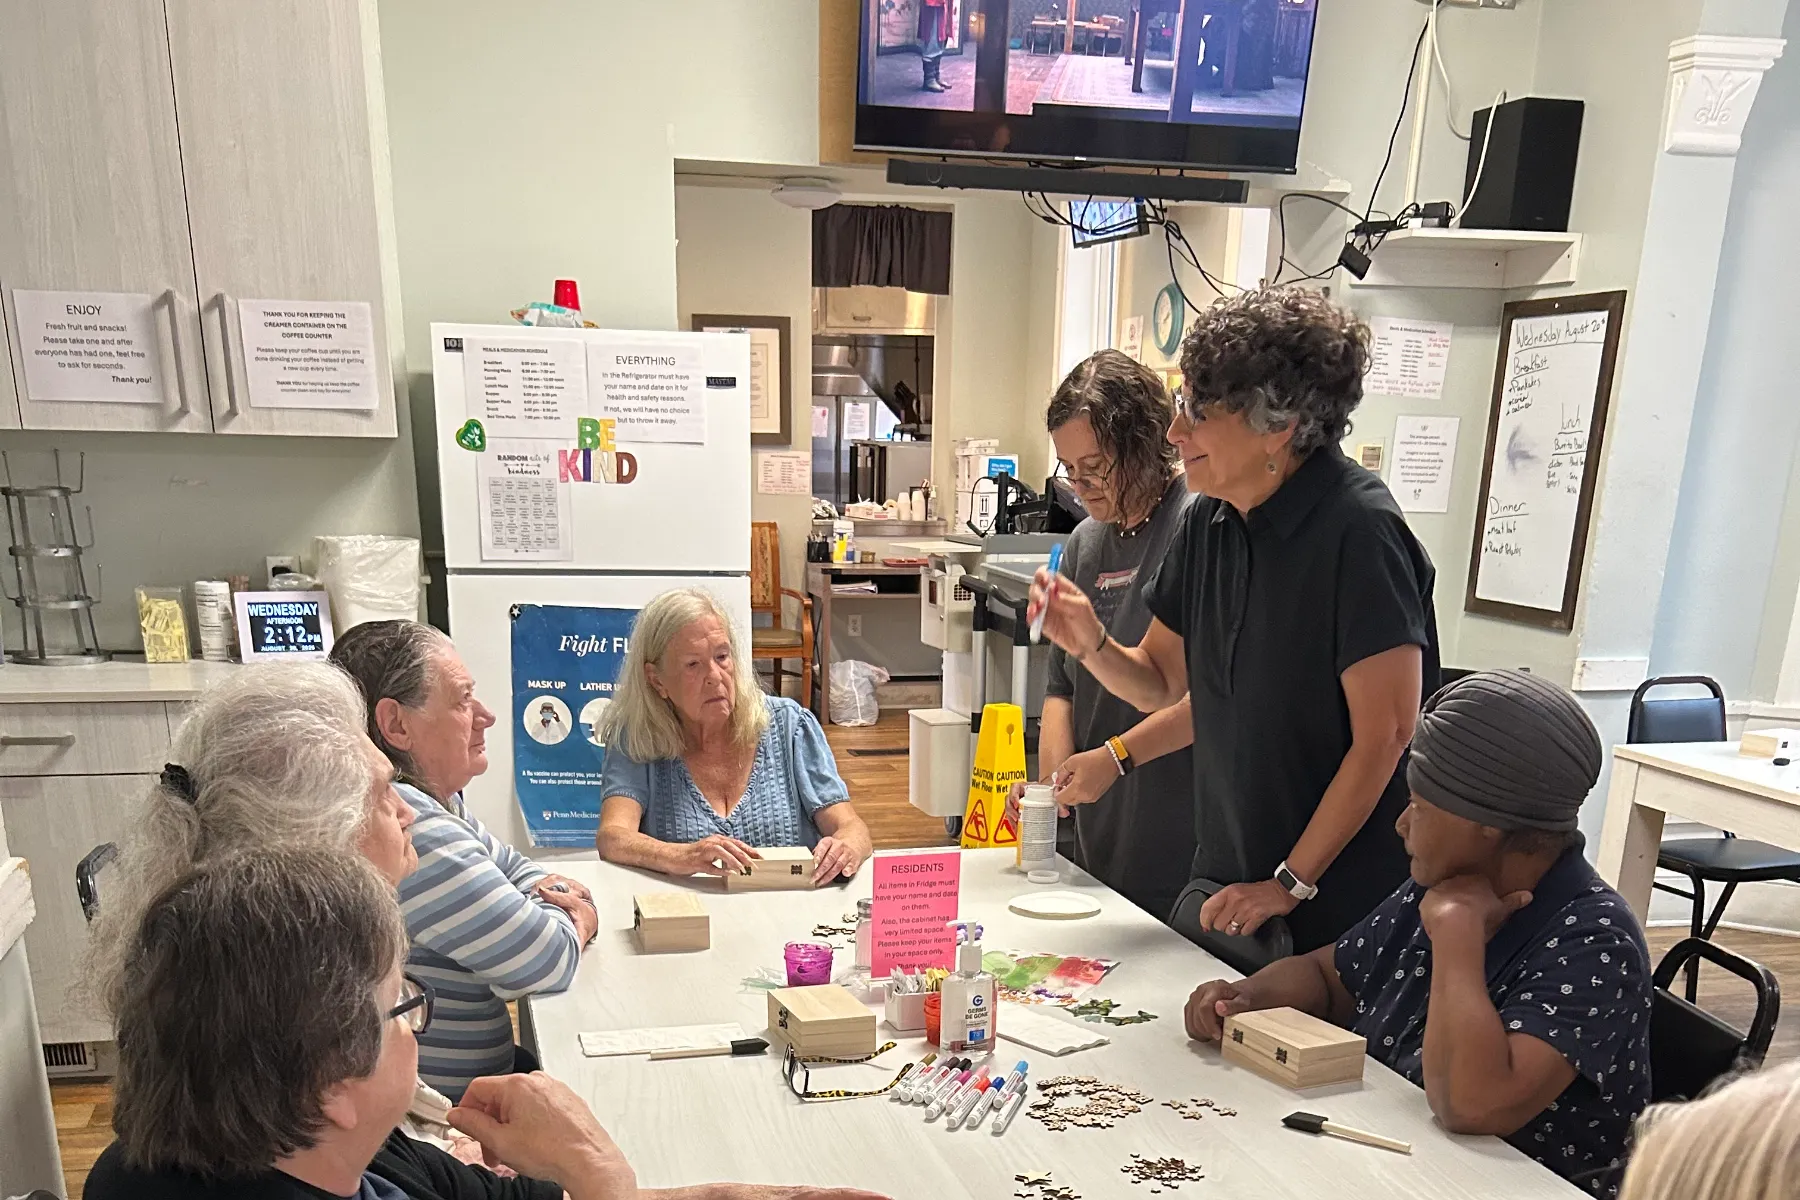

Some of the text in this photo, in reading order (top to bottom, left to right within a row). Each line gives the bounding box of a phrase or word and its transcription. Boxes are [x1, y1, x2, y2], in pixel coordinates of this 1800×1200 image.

[66, 304, 101, 315] ENJOY
[1516, 322, 1561, 348] Wednesday
[1565, 320, 1589, 342] August
[43, 336, 68, 344] Please
[35, 349, 68, 357] everyone
[616, 356, 676, 366] EVERYTHING
[1514, 353, 1547, 375] Breakfast
[640, 394, 659, 403] safety
[578, 418, 616, 451] BE
[508, 467, 540, 476] kindness
[558, 448, 637, 484] KIND
[1489, 497, 1526, 514] Dinner
[248, 604, 317, 616] WEDNESDAY
[558, 635, 630, 657] Fight FL
[555, 681, 566, 689] UP
[973, 767, 994, 781] CAUTION
[996, 770, 1025, 781] CAUTION
[971, 778, 993, 793] Wet Floor
[996, 784, 1008, 793] Wet
[891, 863, 944, 874] RESIDENTS
[893, 894, 907, 902] your
